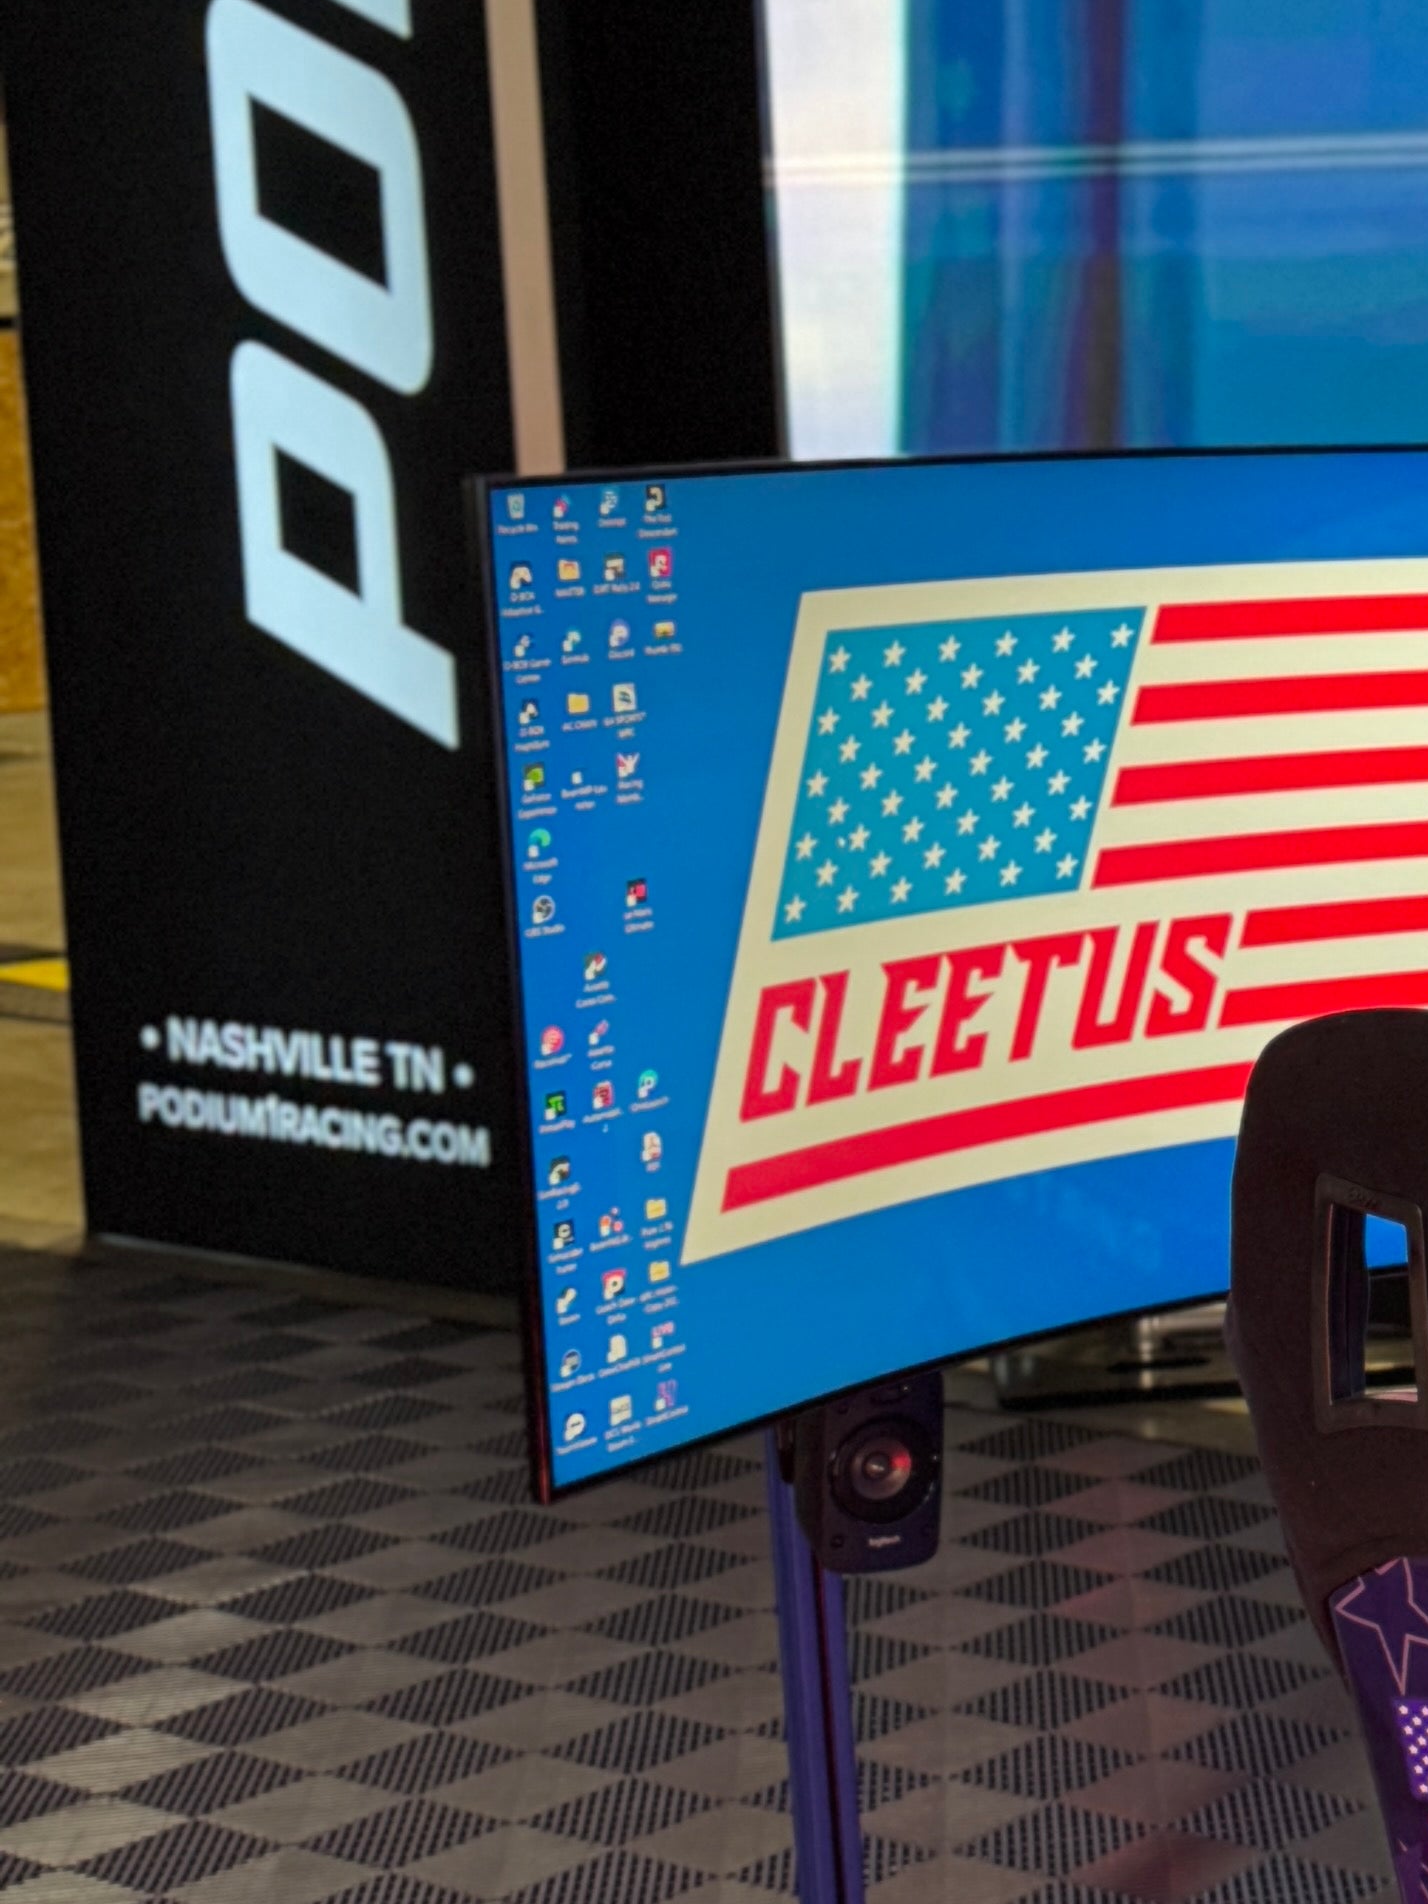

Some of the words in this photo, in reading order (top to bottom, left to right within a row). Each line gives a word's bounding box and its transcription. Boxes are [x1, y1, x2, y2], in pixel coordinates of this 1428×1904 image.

[166, 1014, 382, 1086] NASHVILLE
[385, 1042, 445, 1094] TN
[739, 912, 1234, 1124] CLEETUS
